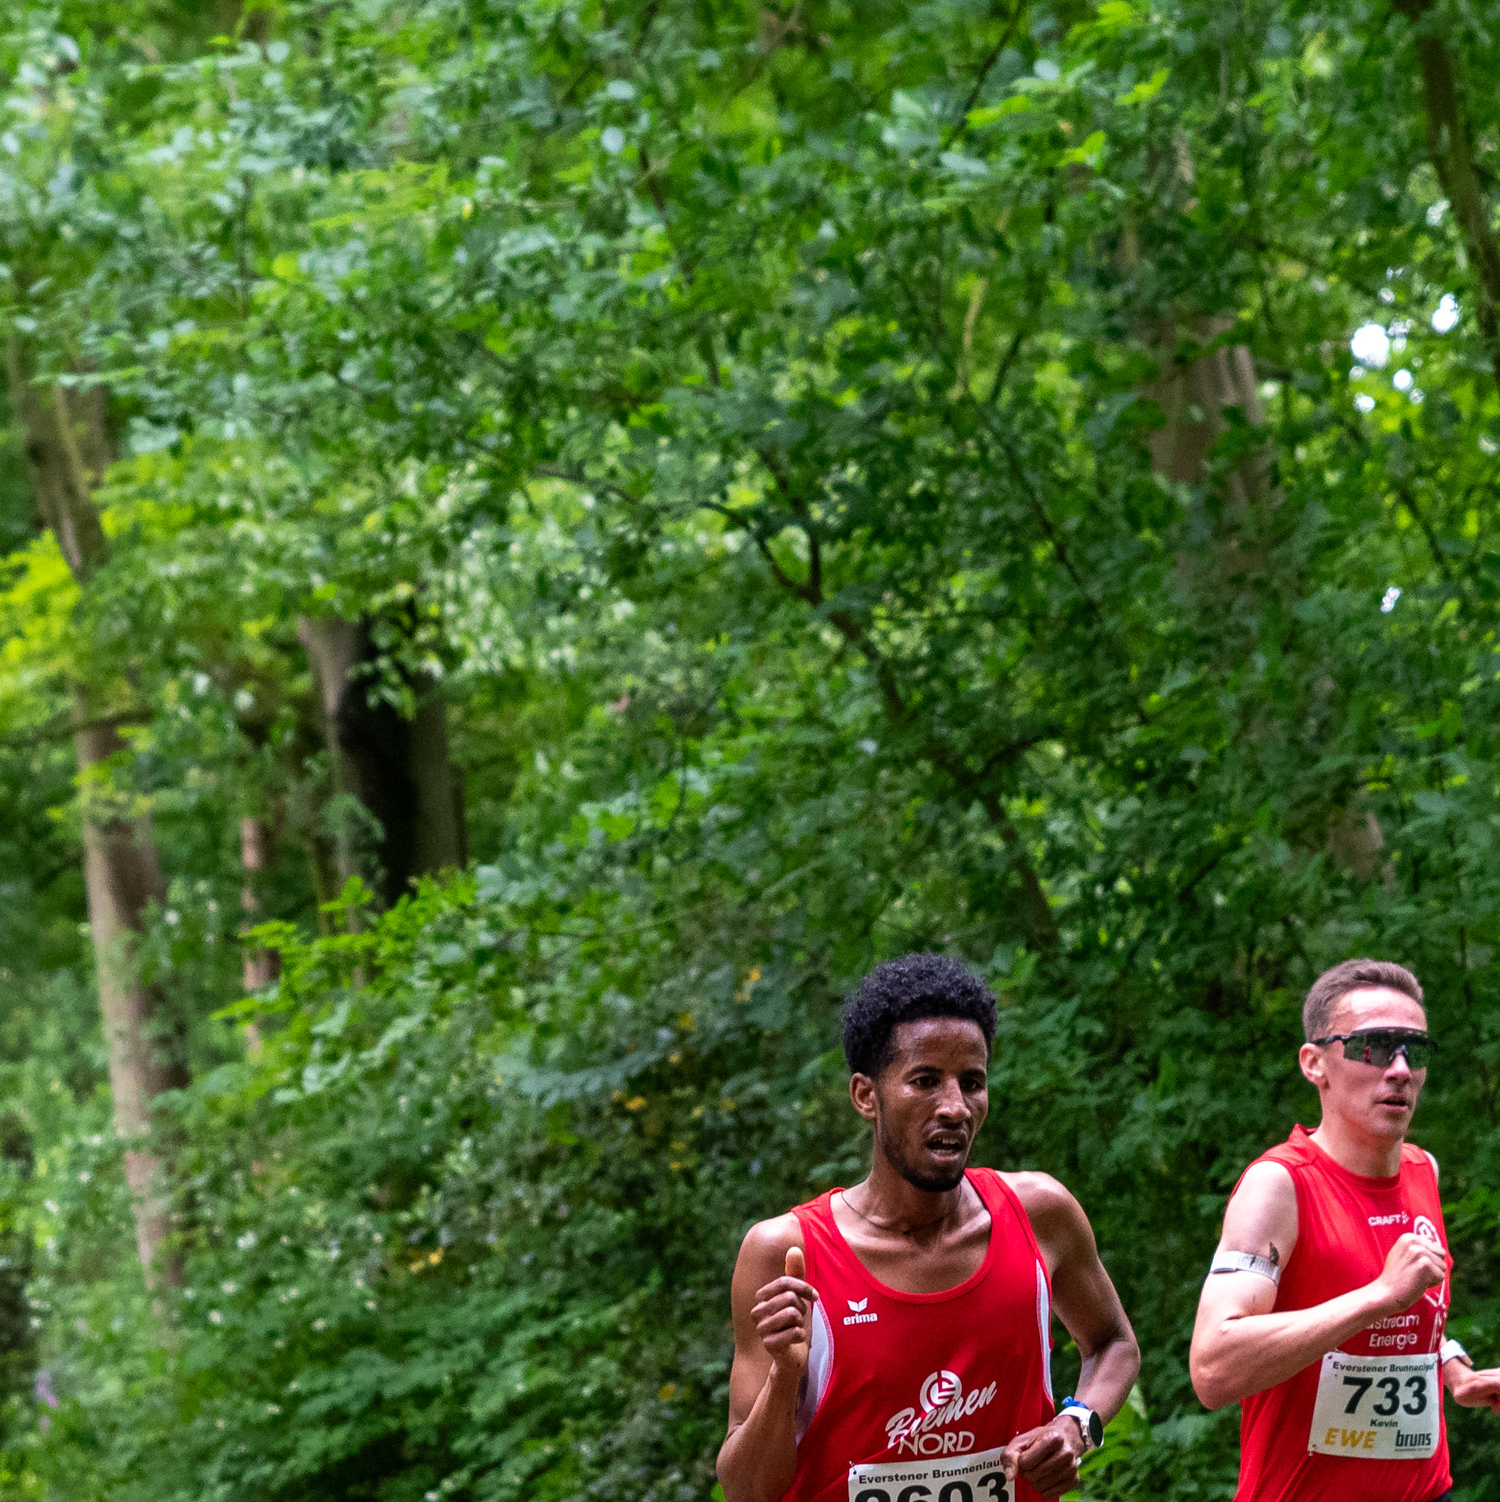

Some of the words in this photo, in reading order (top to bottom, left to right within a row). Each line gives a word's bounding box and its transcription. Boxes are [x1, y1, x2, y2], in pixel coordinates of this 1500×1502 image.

[1368, 1214, 1401, 1226] CRAFT
[843, 1312, 879, 1326] erima
[1333, 1361, 1387, 1373] Everstener
[1342, 1375, 1428, 1416] 733
[885, 1380, 997, 1449] Bremen
[1370, 1418, 1398, 1428] Kevin
[897, 1430, 975, 1456] NORD
[1324, 1427, 1377, 1449] EWE
[1396, 1429, 1431, 1447] bruns
[858, 1471, 929, 1484] Everstener
[932, 1460, 1002, 1479] Brunnenlau
